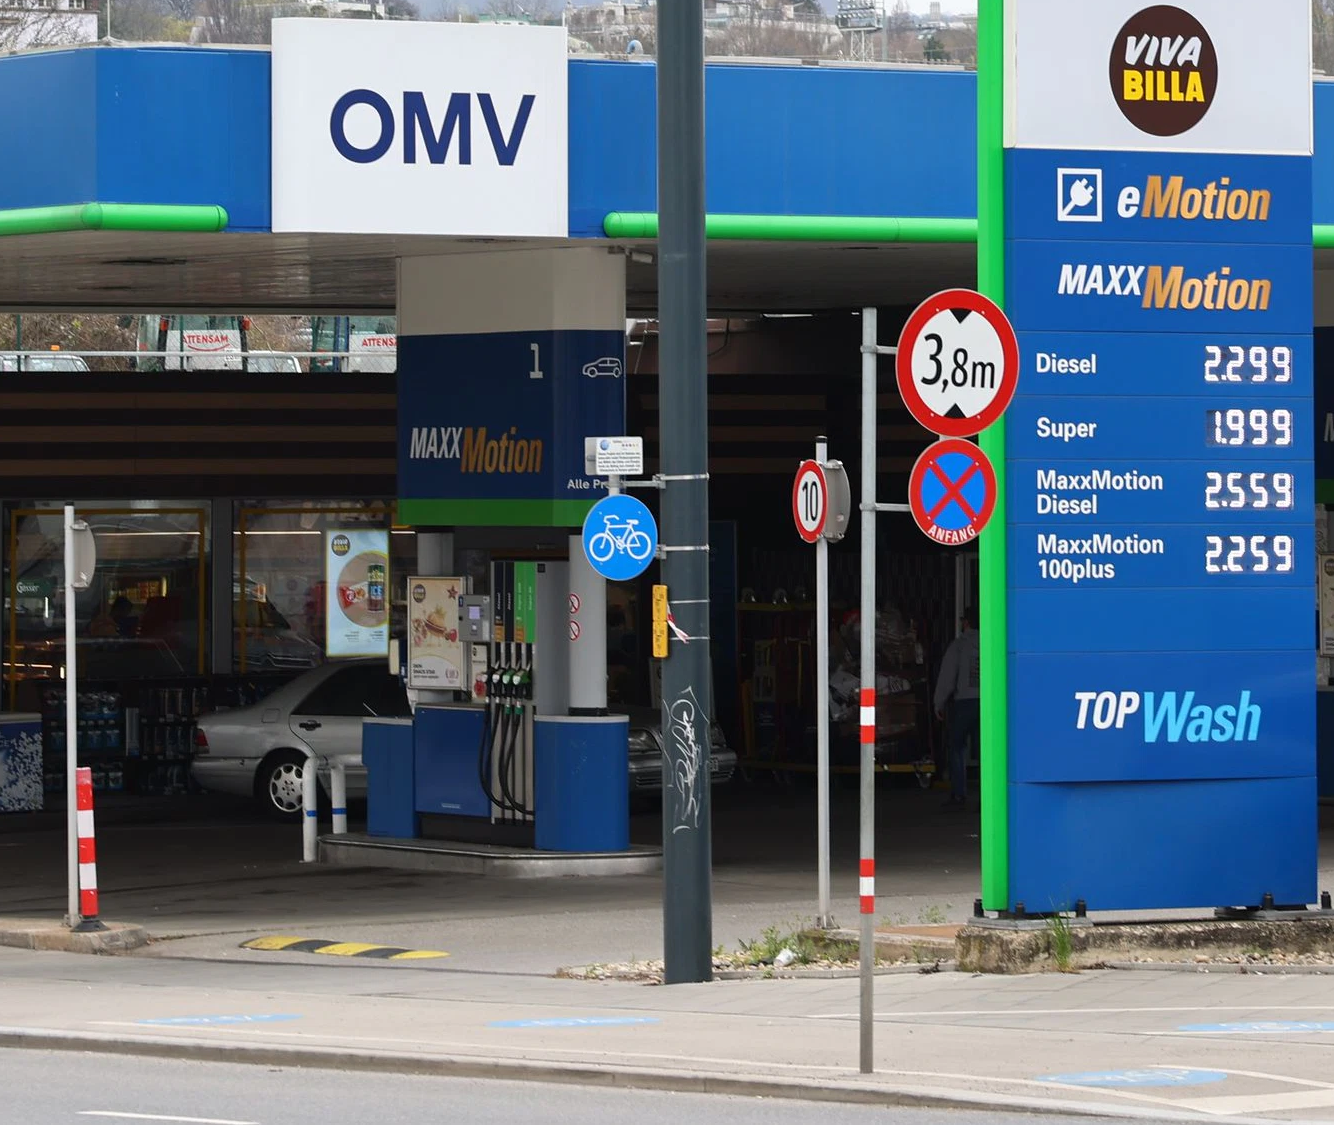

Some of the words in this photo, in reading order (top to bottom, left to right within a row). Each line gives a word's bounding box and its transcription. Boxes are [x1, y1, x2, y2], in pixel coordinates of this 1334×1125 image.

[1124, 33, 1203, 68] VIVA
[1123, 69, 1206, 103] BILLA
[329, 88, 537, 167] OMV
[1116, 175, 1271, 221] eMotion
[529, 342, 544, 379] 1
[1035, 353, 1097, 374] Diesel
[1204, 345, 1292, 383] 2.299
[1036, 416, 1097, 442] Super
[1214, 408, 1292, 445] 1.999
[567, 478, 590, 490] Alle
[1036, 469, 1164, 491] MaxxMotion
[1205, 471, 1293, 509] 2.559
[801, 480, 819, 523] 10
[1036, 493, 1098, 515] Diesel
[927, 524, 977, 543] ANFANG
[1037, 533, 1164, 554] MaxxMotion
[1038, 559, 1115, 584] 100plus
[1205, 535, 1293, 572] 2.259
